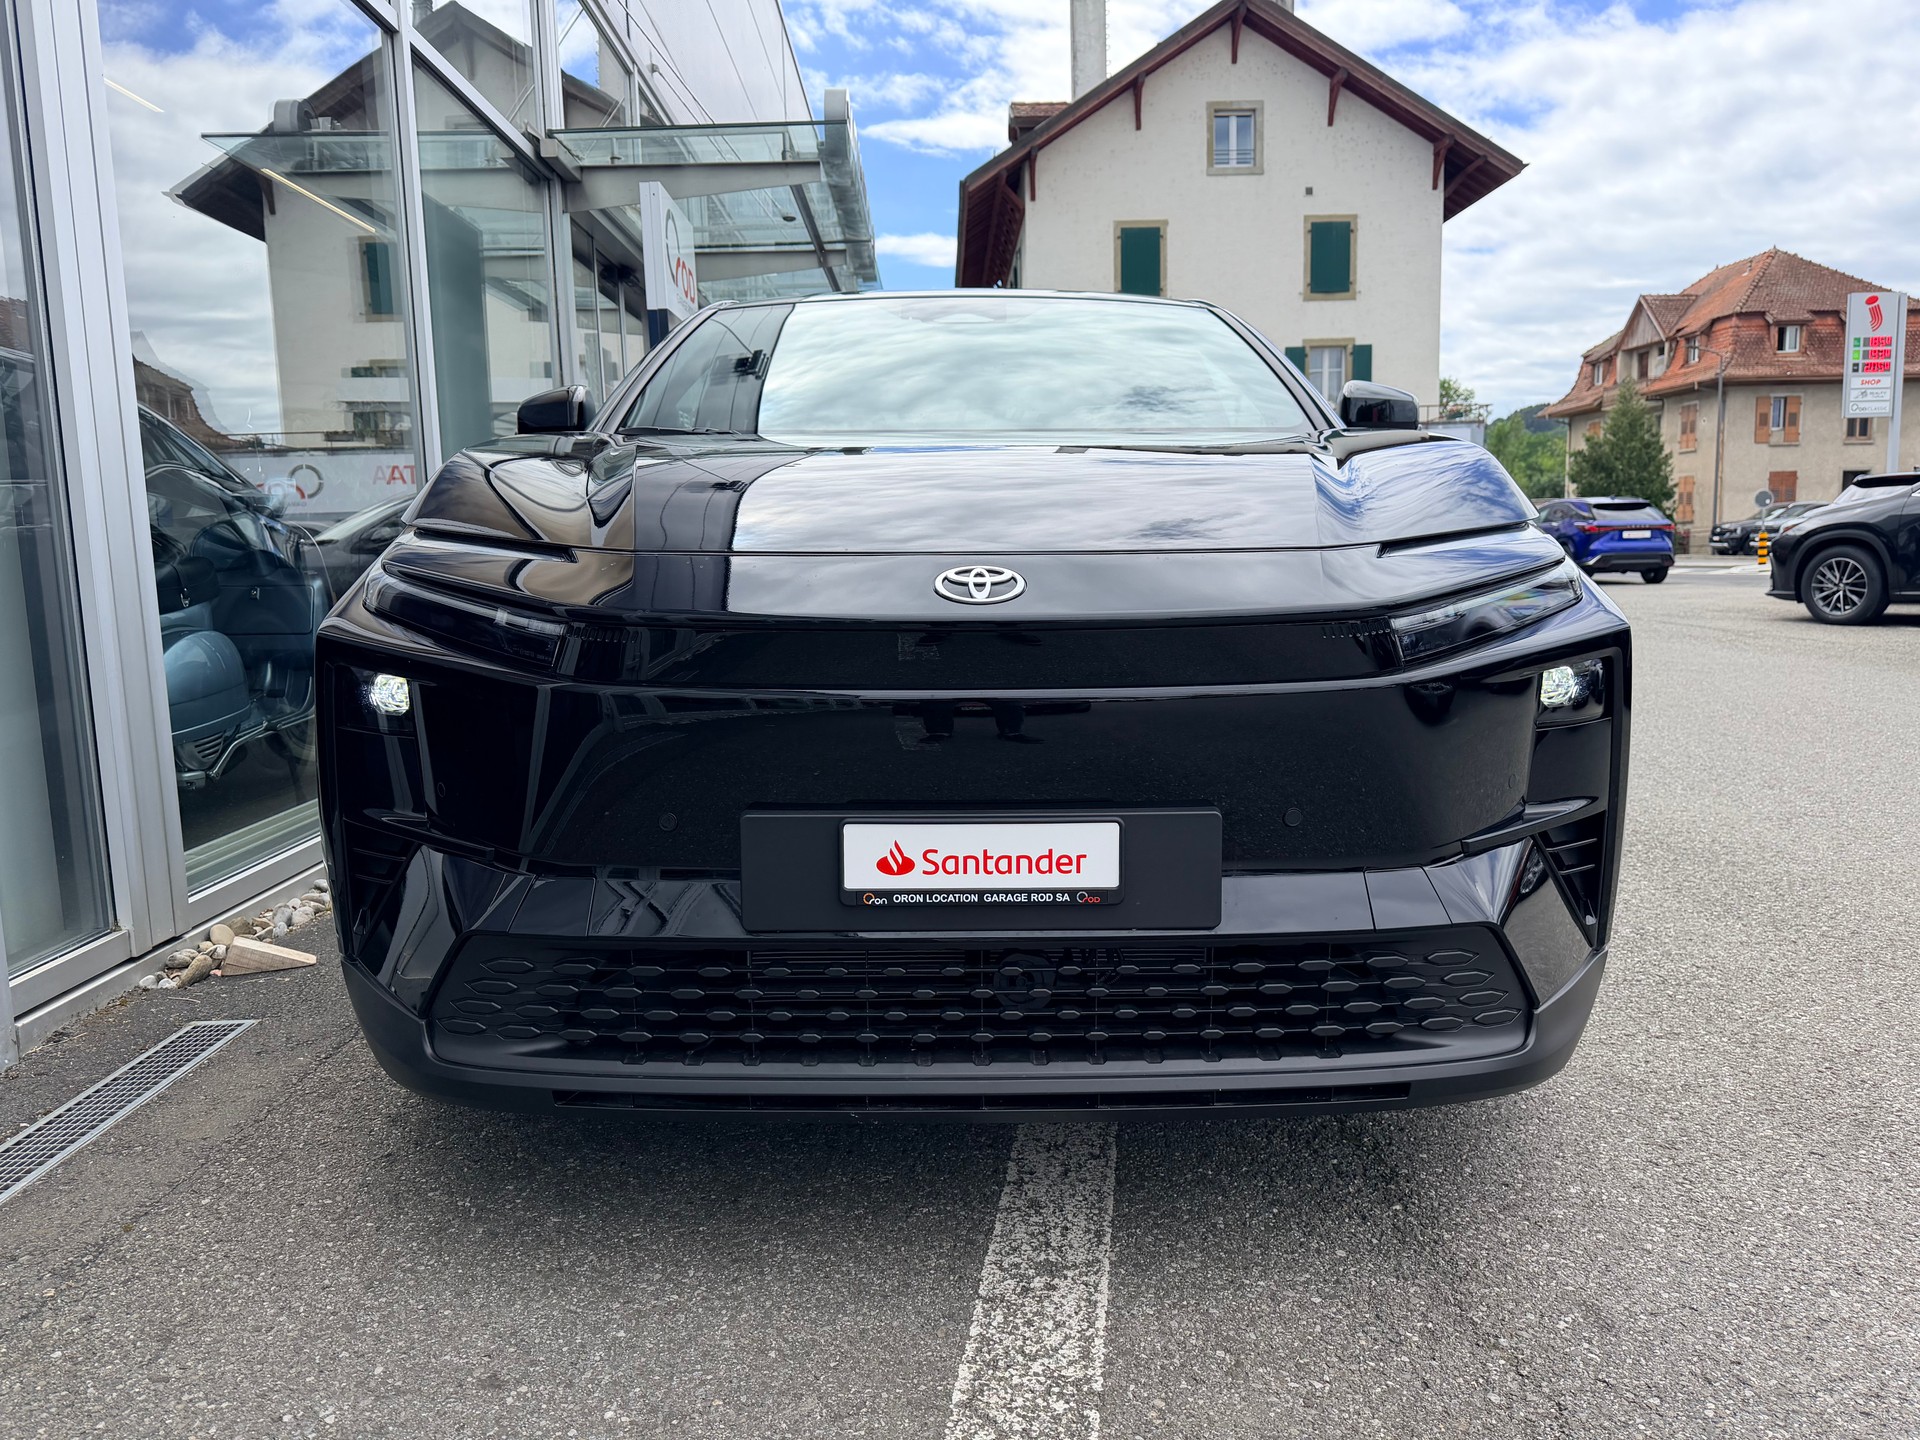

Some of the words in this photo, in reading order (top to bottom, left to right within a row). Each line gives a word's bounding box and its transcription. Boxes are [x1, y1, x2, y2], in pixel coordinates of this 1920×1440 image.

[922, 848, 1087, 875] Santander
[893, 894, 923, 903] ORON
[926, 894, 978, 903] LOCATION
[983, 893, 1028, 902] GARAGE
[1031, 893, 1053, 902] ROD
[1056, 893, 1071, 902] SA
